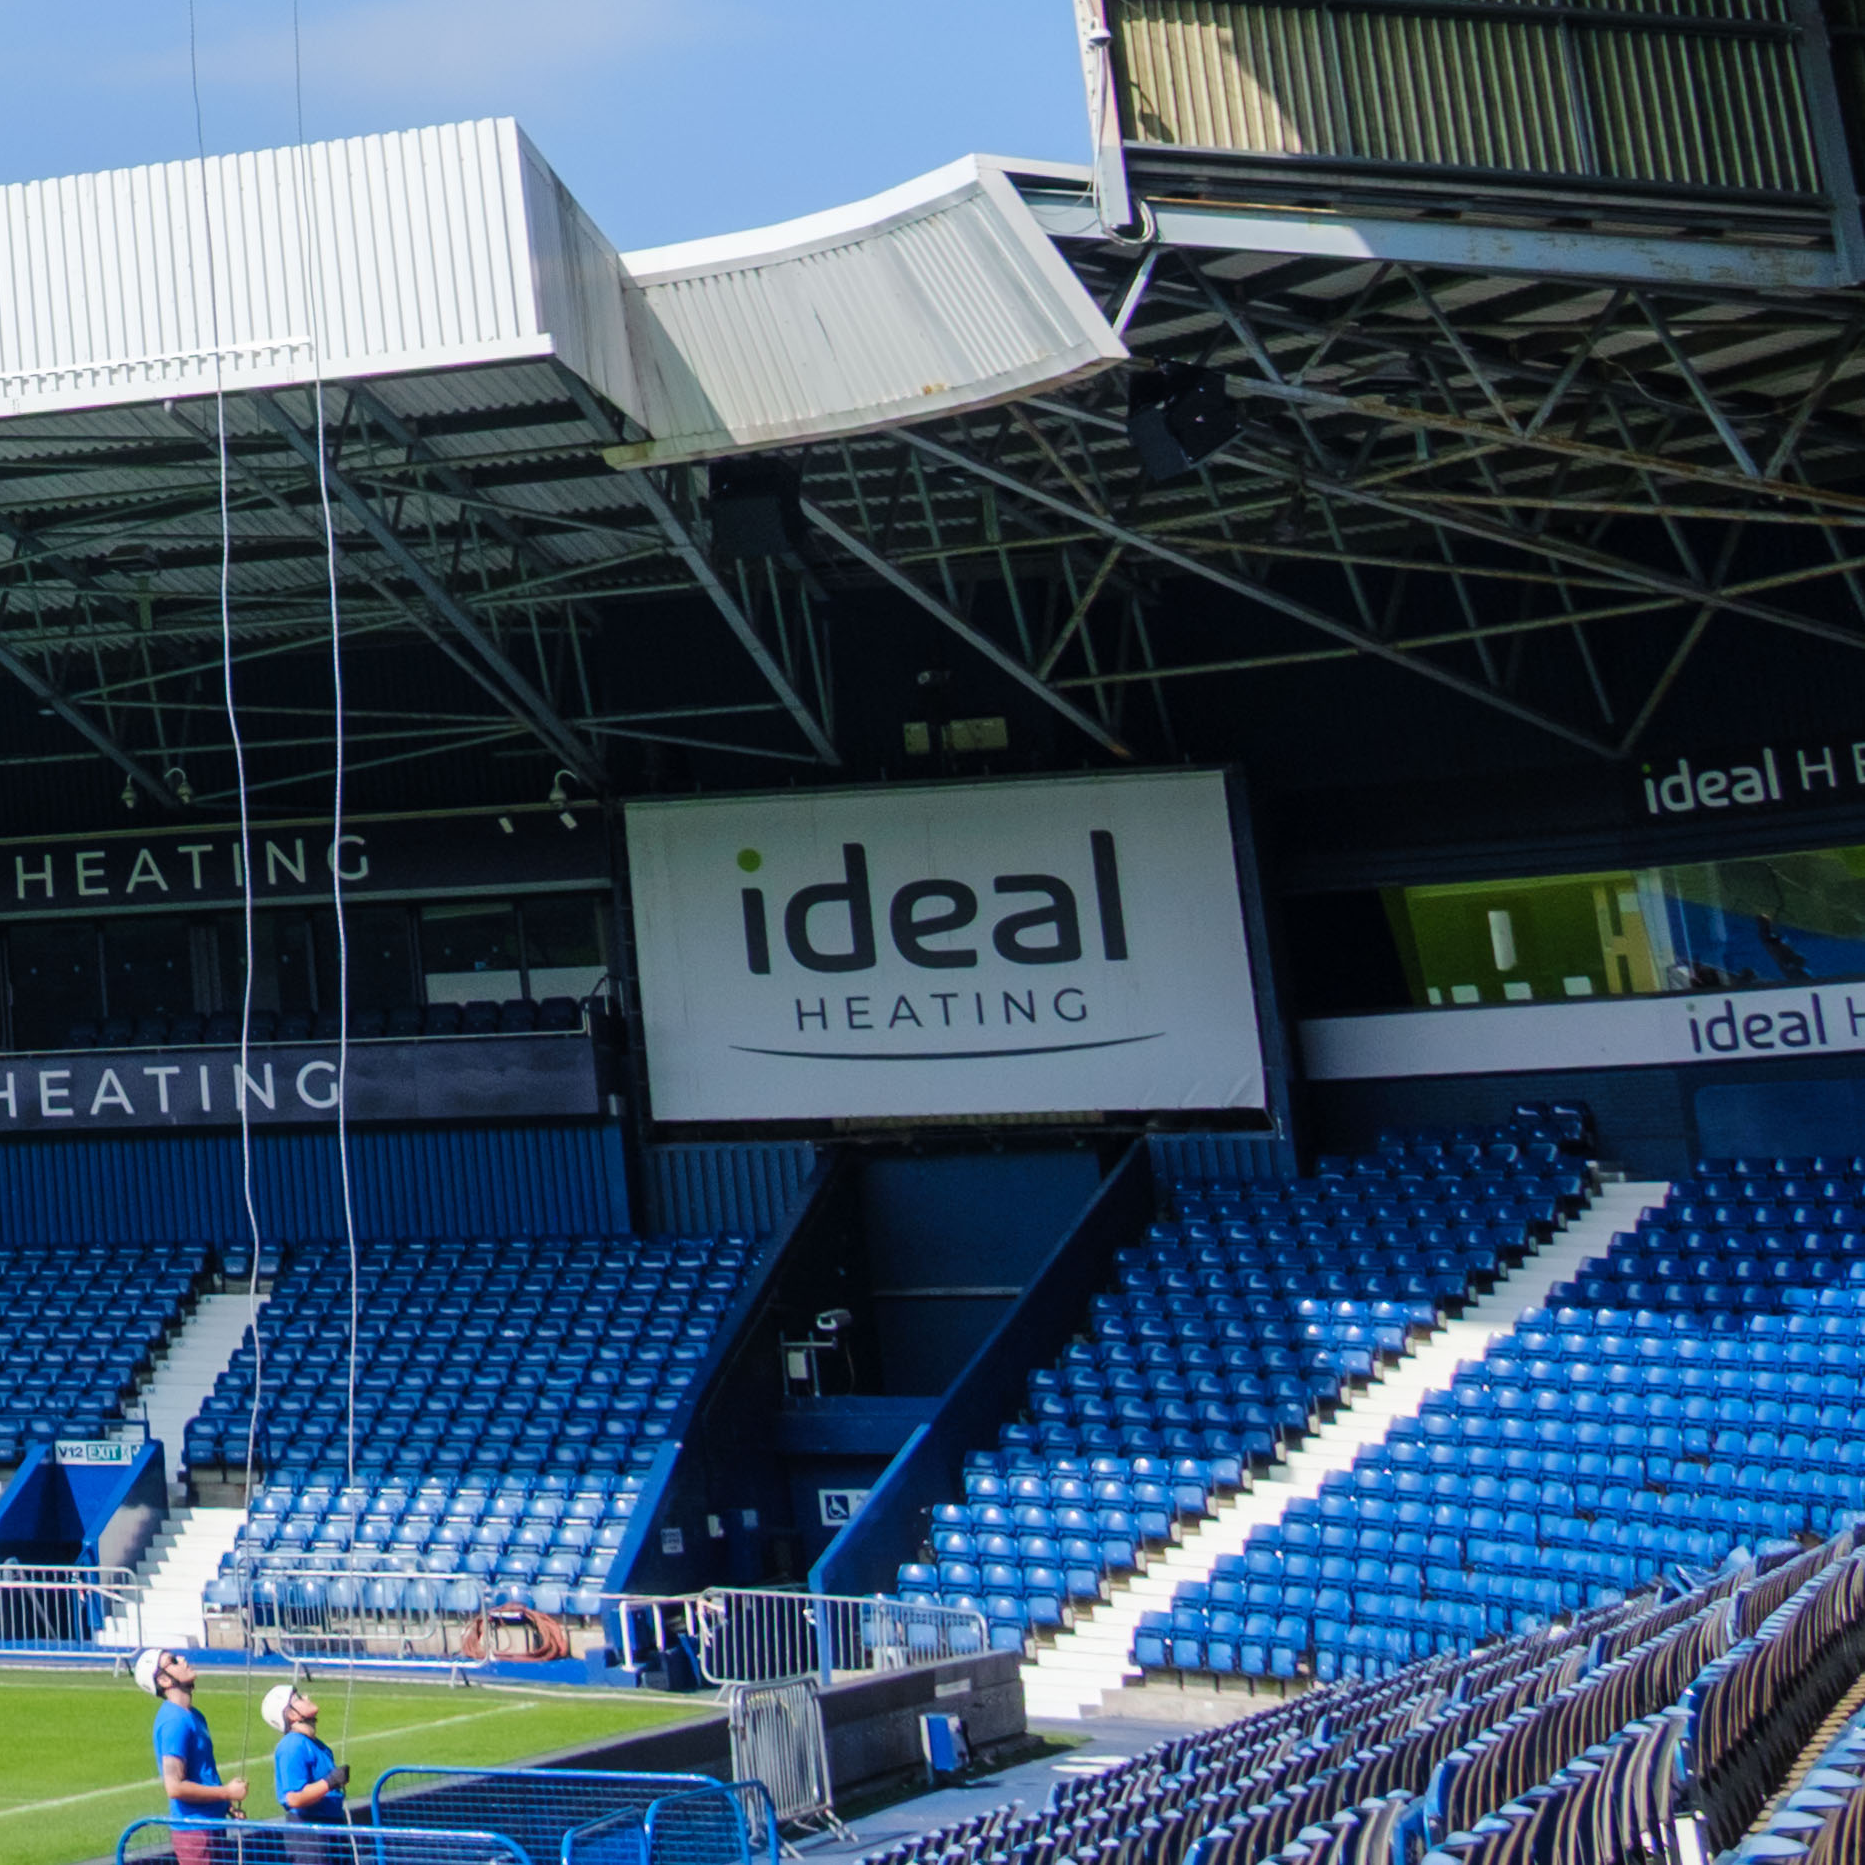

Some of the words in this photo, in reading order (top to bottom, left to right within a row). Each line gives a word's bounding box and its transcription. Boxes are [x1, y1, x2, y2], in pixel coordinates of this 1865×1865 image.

[1641, 747, 1781, 814] ideal
[16, 835, 371, 900] HEATING
[736, 829, 1128, 974] ideal
[795, 987, 1089, 1031] HEATING
[1687, 993, 1828, 1053] ideal
[58, 1446, 83, 1458] V12
[88, 1445, 120, 1460] EXIT
